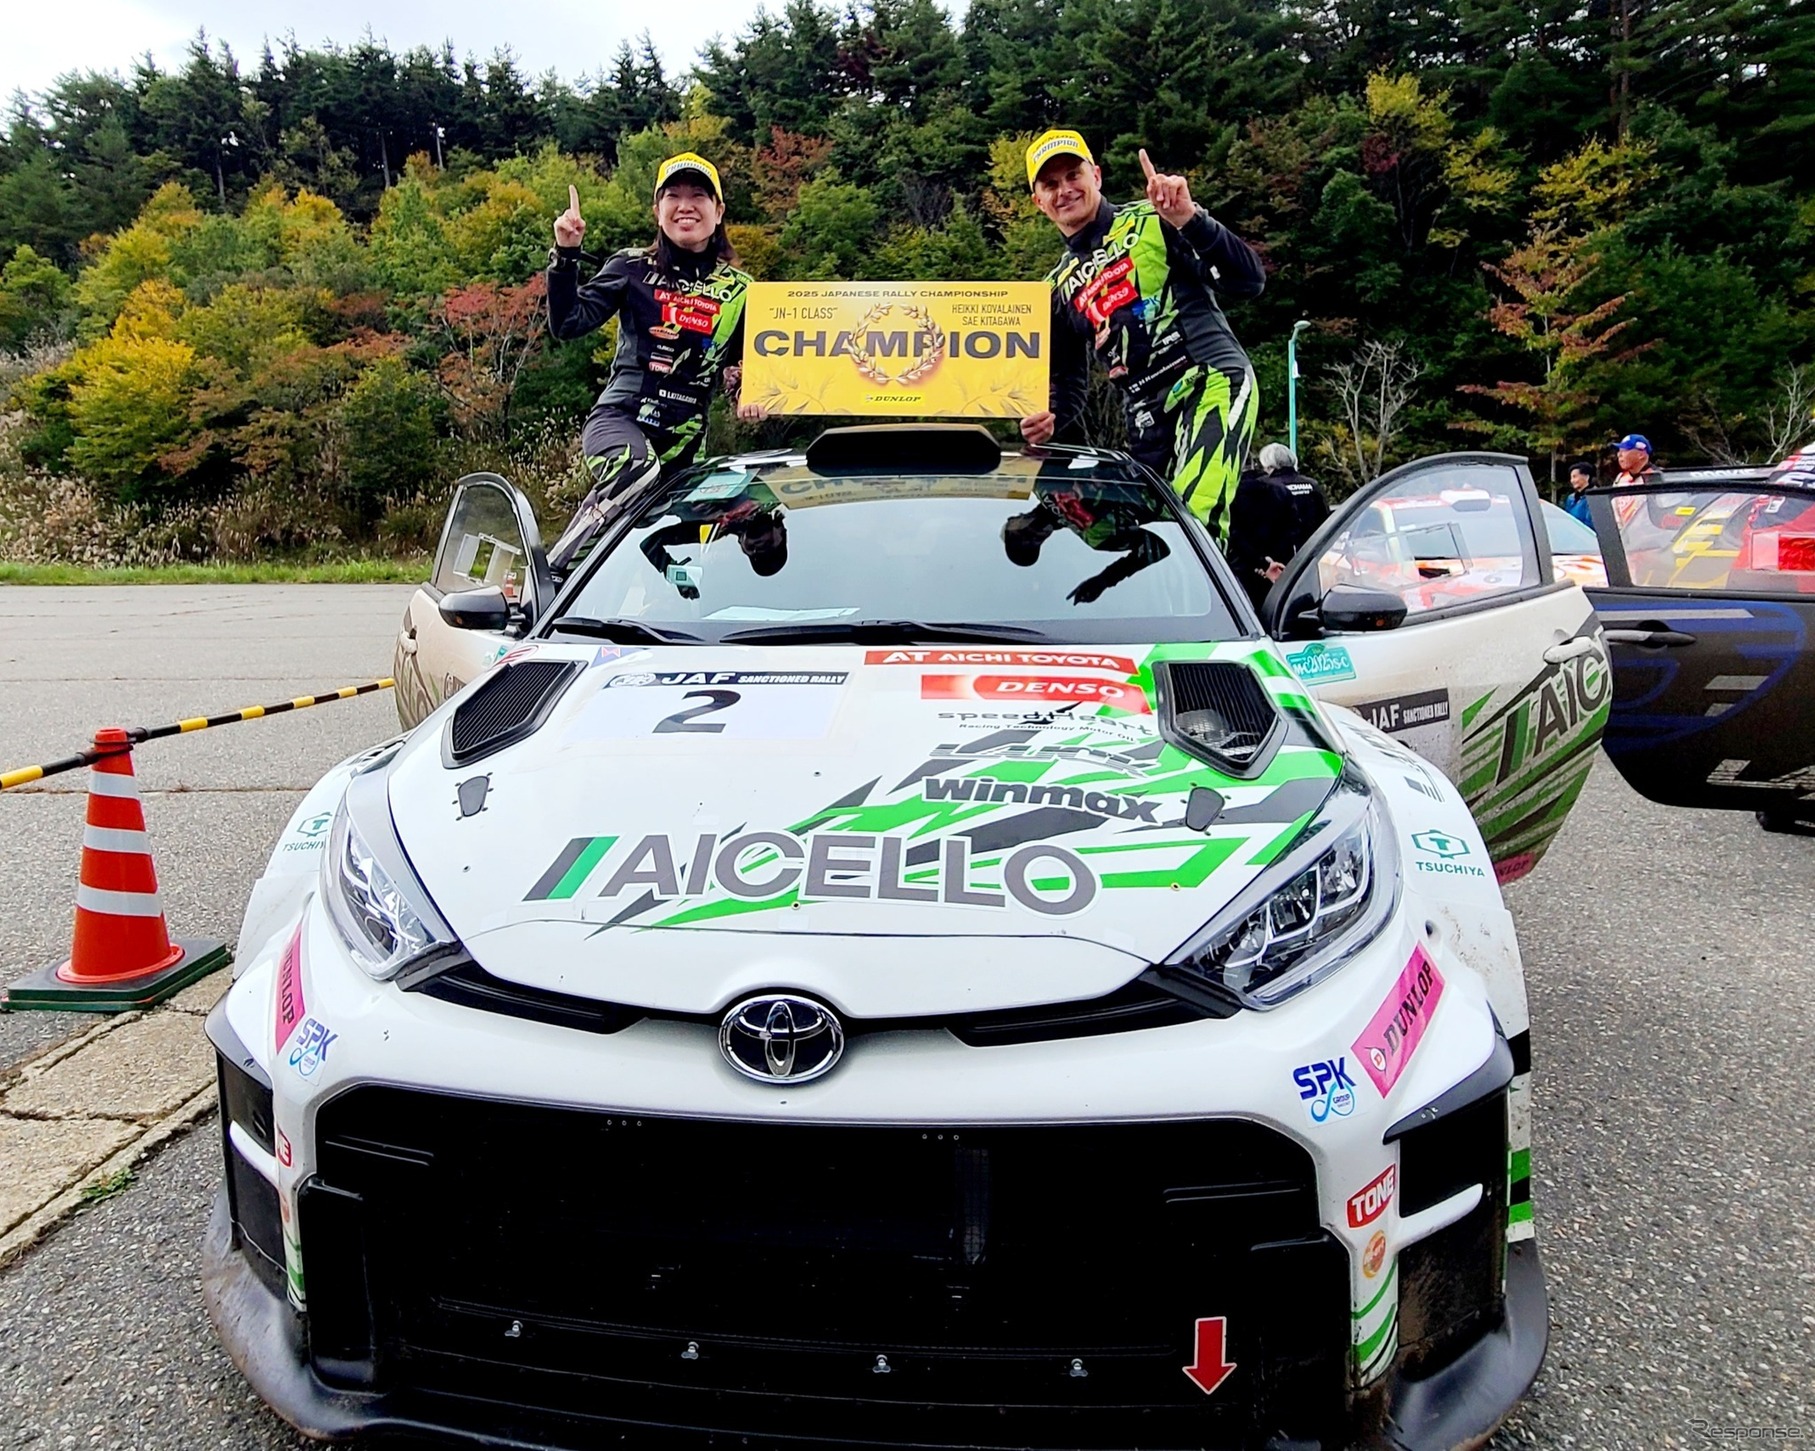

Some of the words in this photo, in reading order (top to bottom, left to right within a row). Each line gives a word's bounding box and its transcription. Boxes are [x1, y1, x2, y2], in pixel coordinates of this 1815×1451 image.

[952, 304, 980, 315] HEIKKI
[981, 304, 1032, 315] KOVALAINEN
[962, 316, 979, 326] SAE
[980, 316, 1021, 327] KITAGAWA
[754, 330, 1041, 359] CHAMPION
[883, 652, 933, 663] AT
[938, 653, 1011, 663] AICHI
[1017, 654, 1121, 669] TOYOTA
[661, 672, 736, 685] JAF
[737, 675, 809, 684] SANCTIONED
[810, 675, 846, 684] RALLY
[996, 681, 1125, 698] DENSO
[652, 689, 741, 733] 2
[1367, 703, 1400, 729] JAF
[1403, 704, 1434, 724] SANCTIONED
[1434, 701, 1449, 718] RALLY
[1079, 726, 1113, 735] Motor
[1118, 733, 1135, 742] Oil
[597, 832, 1097, 916] AICELLO
[1415, 861, 1486, 877] TSUCHIYA
[1383, 960, 1435, 1054] DUNLOP
[296, 1018, 339, 1061] SPK
[1293, 1057, 1357, 1100] SPK
[1351, 1167, 1395, 1222] TONE
